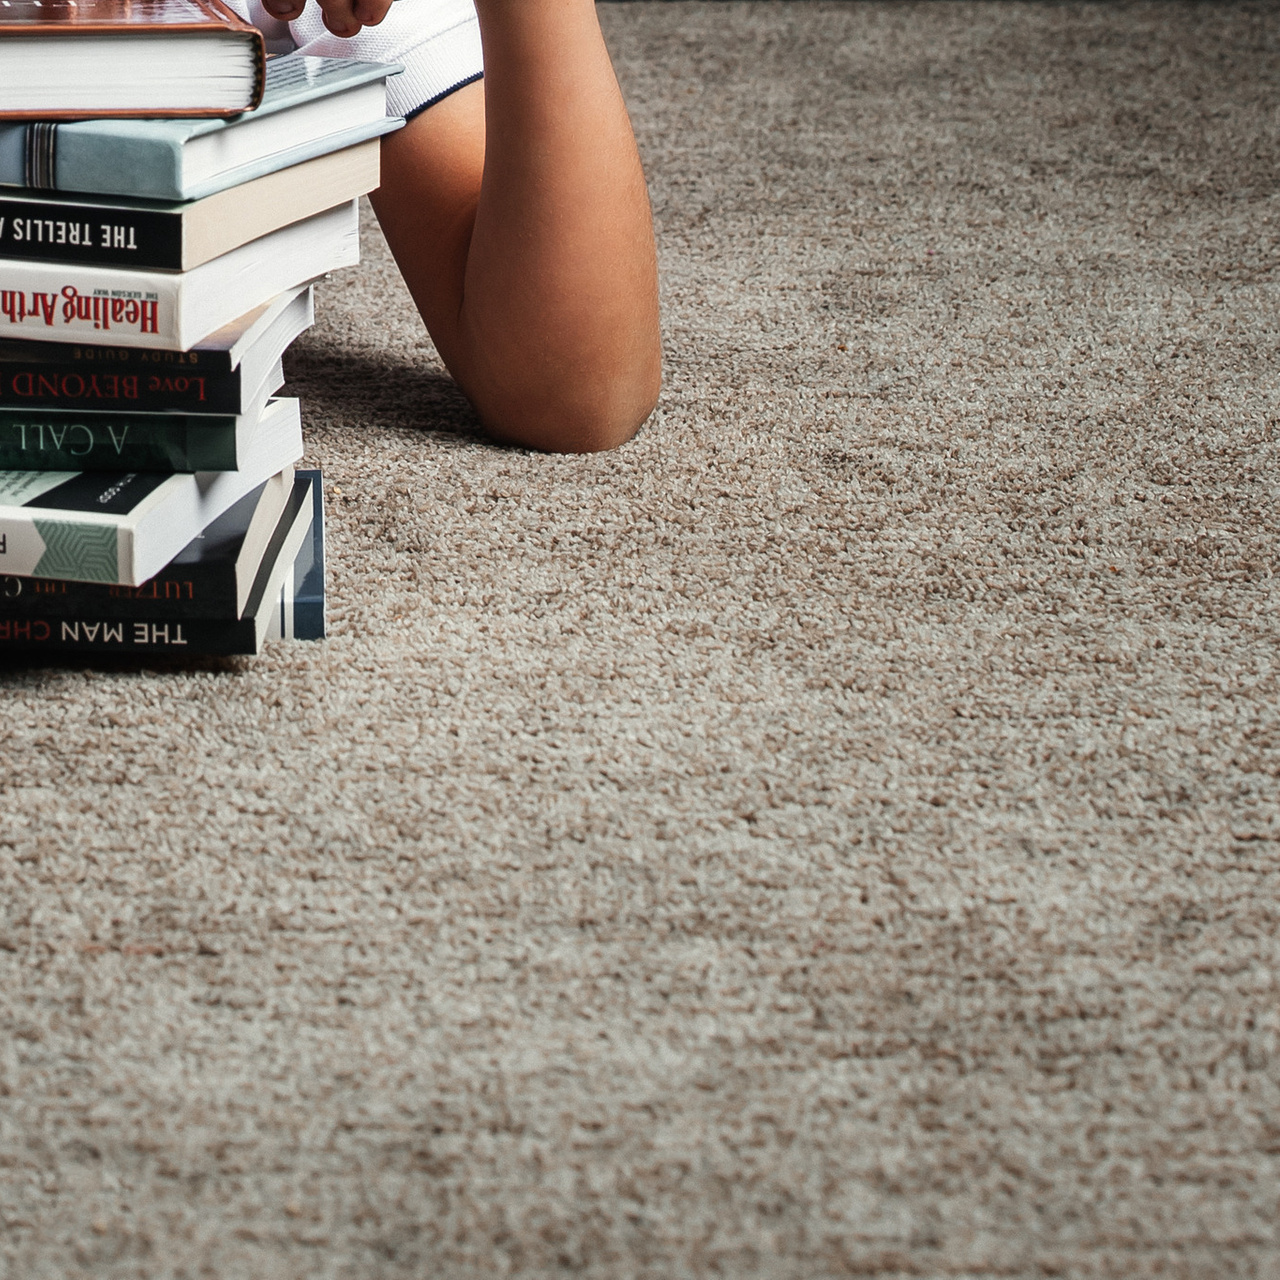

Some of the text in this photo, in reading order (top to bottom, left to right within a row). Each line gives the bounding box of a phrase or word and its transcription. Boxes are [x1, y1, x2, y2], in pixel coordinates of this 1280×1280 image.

[13, 218, 92, 245] TRELLIS
[101, 225, 137, 249] THE
[61, 285, 159, 334] Healing
[73, 348, 198, 364] STUDY GUIDE
[12, 372, 138, 399] BEYOND
[149, 376, 206, 400] Love
[13, 424, 94, 455] CALL
[107, 425, 128, 454] A
[34, 581, 67, 595] THE
[61, 620, 123, 642] MAN
[134, 623, 187, 644] THE
